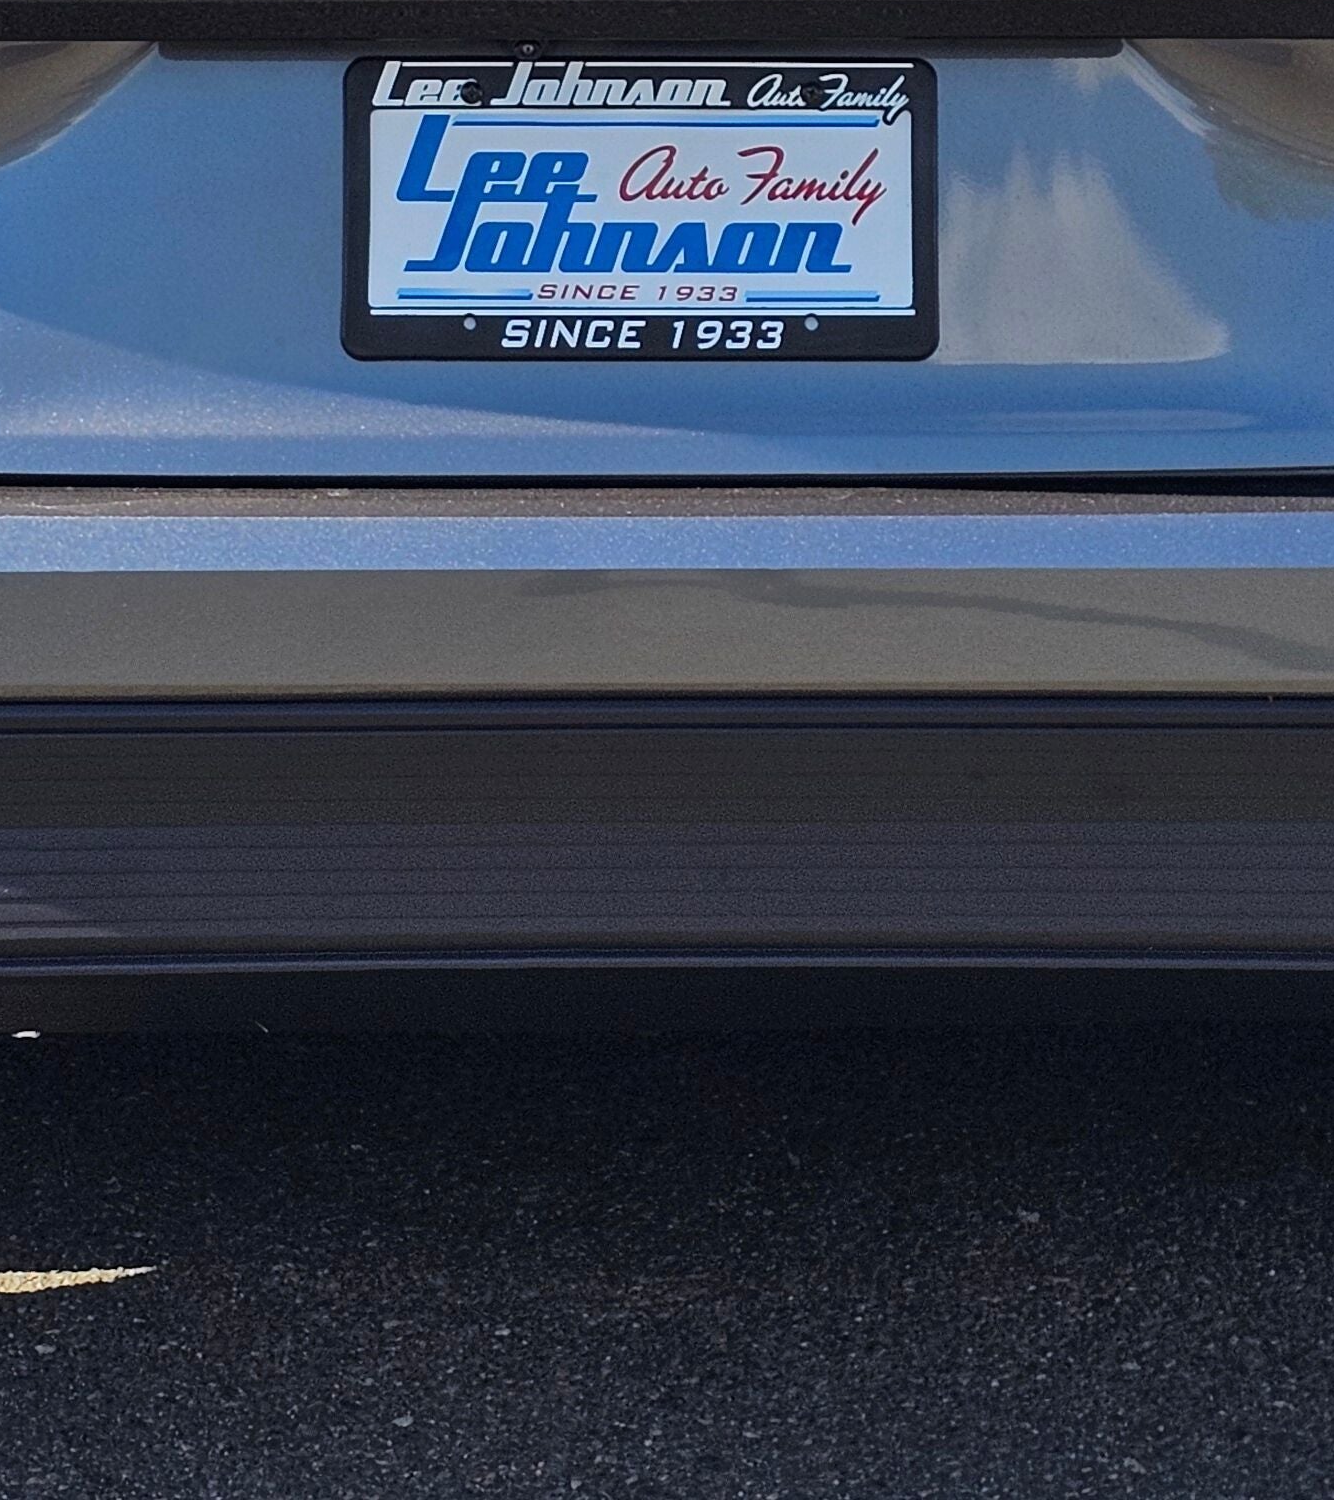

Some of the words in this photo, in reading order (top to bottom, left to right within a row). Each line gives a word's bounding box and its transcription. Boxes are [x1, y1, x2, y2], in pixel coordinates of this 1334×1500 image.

[489, 60, 731, 107] Johnson
[746, 73, 811, 109] Aut
[818, 73, 910, 122] Family
[396, 114, 598, 203] Lee
[619, 145, 731, 202] Auto
[737, 147, 888, 227] Family
[403, 190, 853, 273] Johnson
[537, 283, 641, 301] SINCE
[658, 284, 738, 302] 1933
[500, 318, 647, 350] SINCE
[671, 319, 785, 351] 1933
